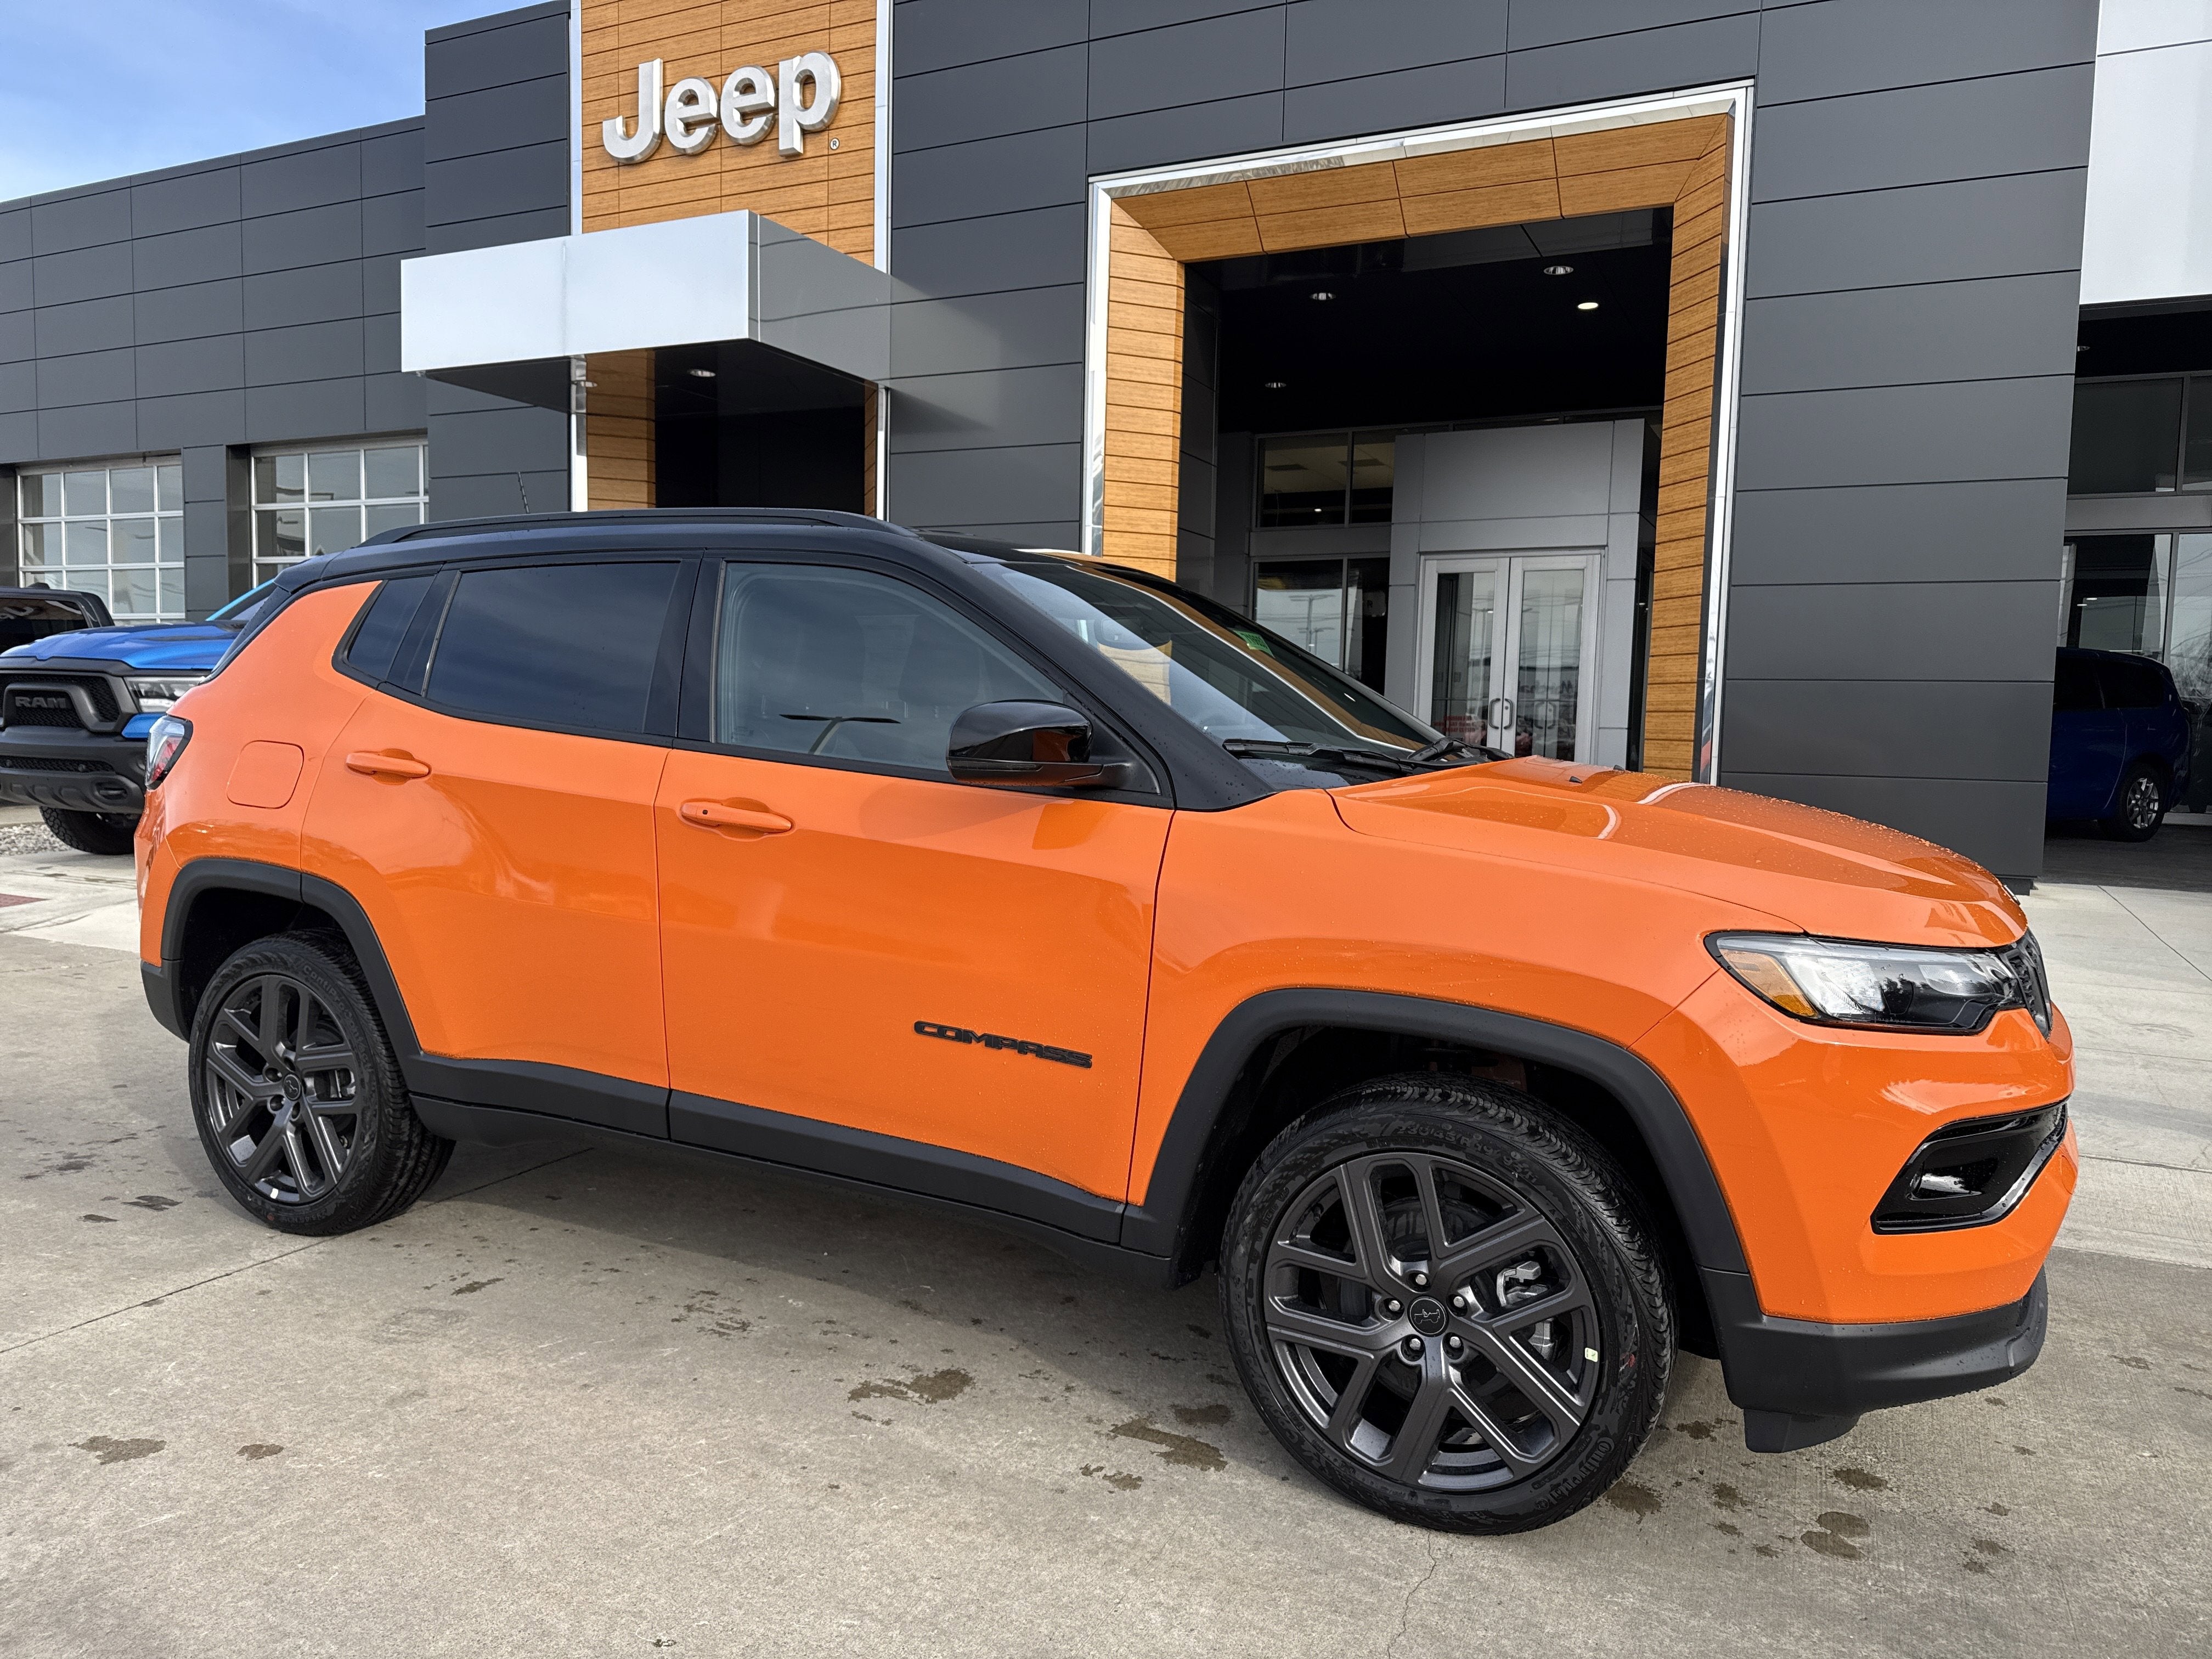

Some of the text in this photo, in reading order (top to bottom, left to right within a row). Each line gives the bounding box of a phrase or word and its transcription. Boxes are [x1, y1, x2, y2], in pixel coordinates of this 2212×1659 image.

[602, 50, 842, 163] Jeep
[15, 696, 66, 709] RAM
[915, 1020, 1092, 1068] COMPASS
[1549, 1436, 1615, 1505] Continental
